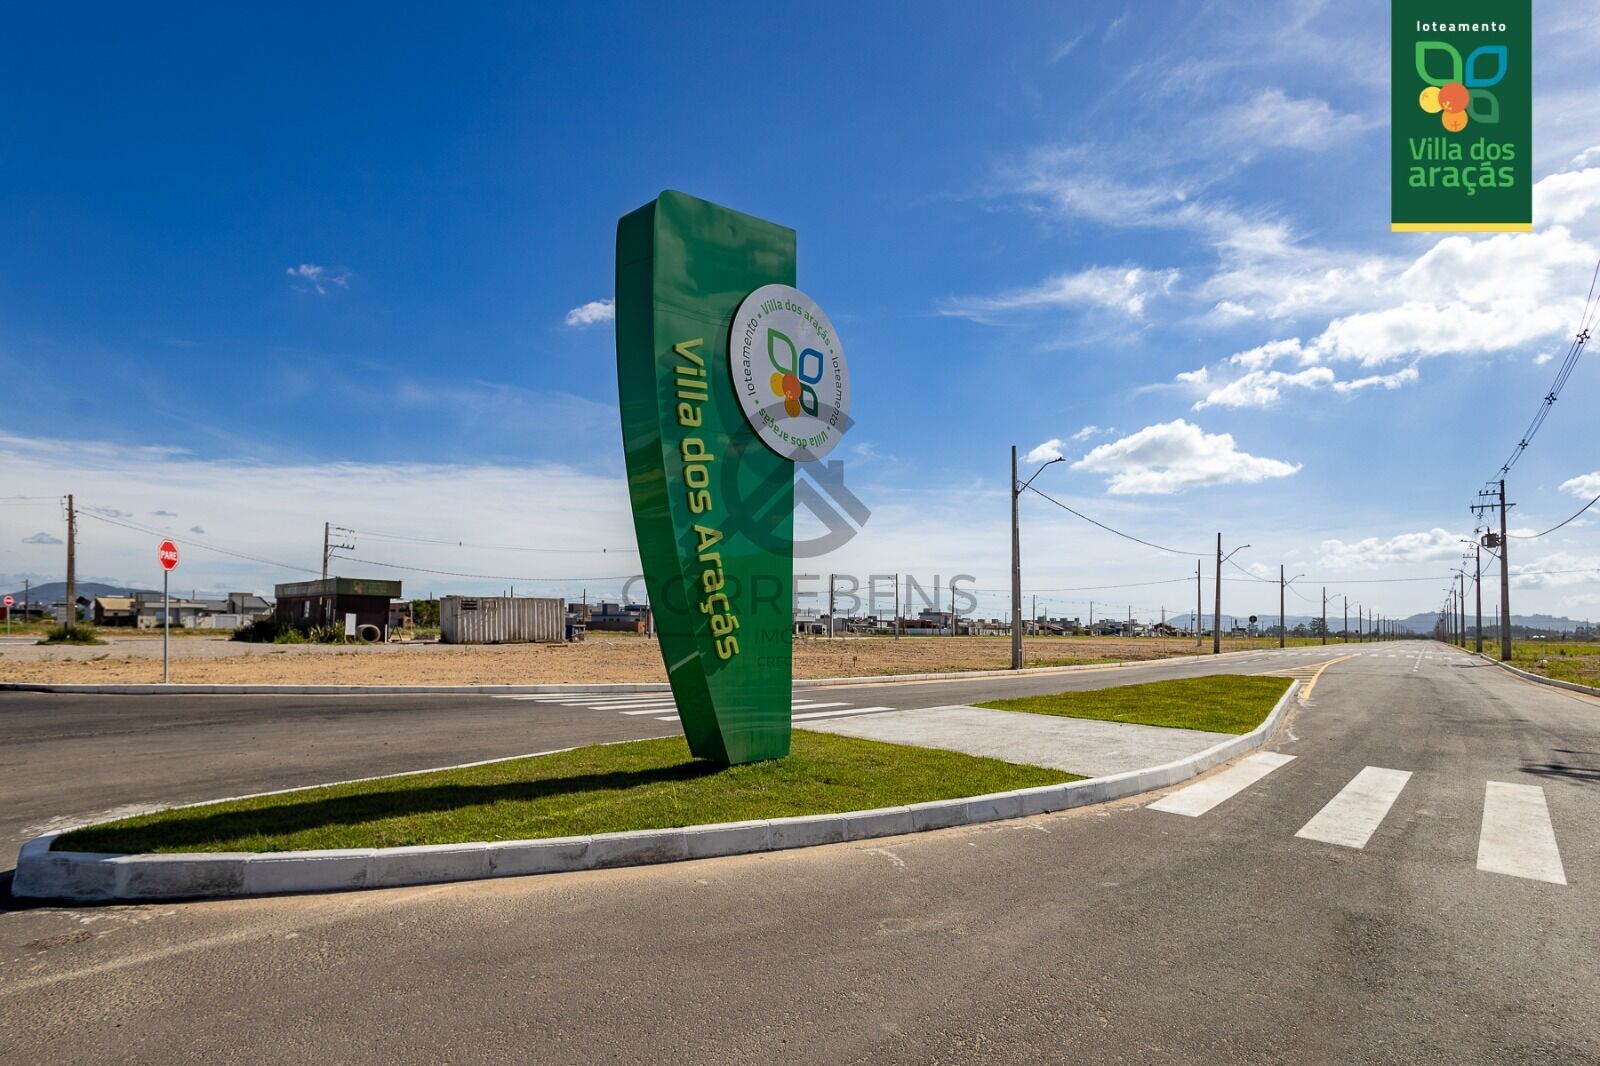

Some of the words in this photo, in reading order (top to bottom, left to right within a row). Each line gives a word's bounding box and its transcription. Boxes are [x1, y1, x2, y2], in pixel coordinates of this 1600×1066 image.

[761, 299, 783, 315] Villa
[785, 299, 802, 315] dos
[742, 318, 758, 397] loteamento
[673, 337, 709, 428] Villa
[829, 356, 843, 426] loteamento
[790, 436, 808, 449] dos
[809, 431, 829, 448] Villa
[680, 437, 715, 515] dos
[160, 550, 177, 561] PARE
